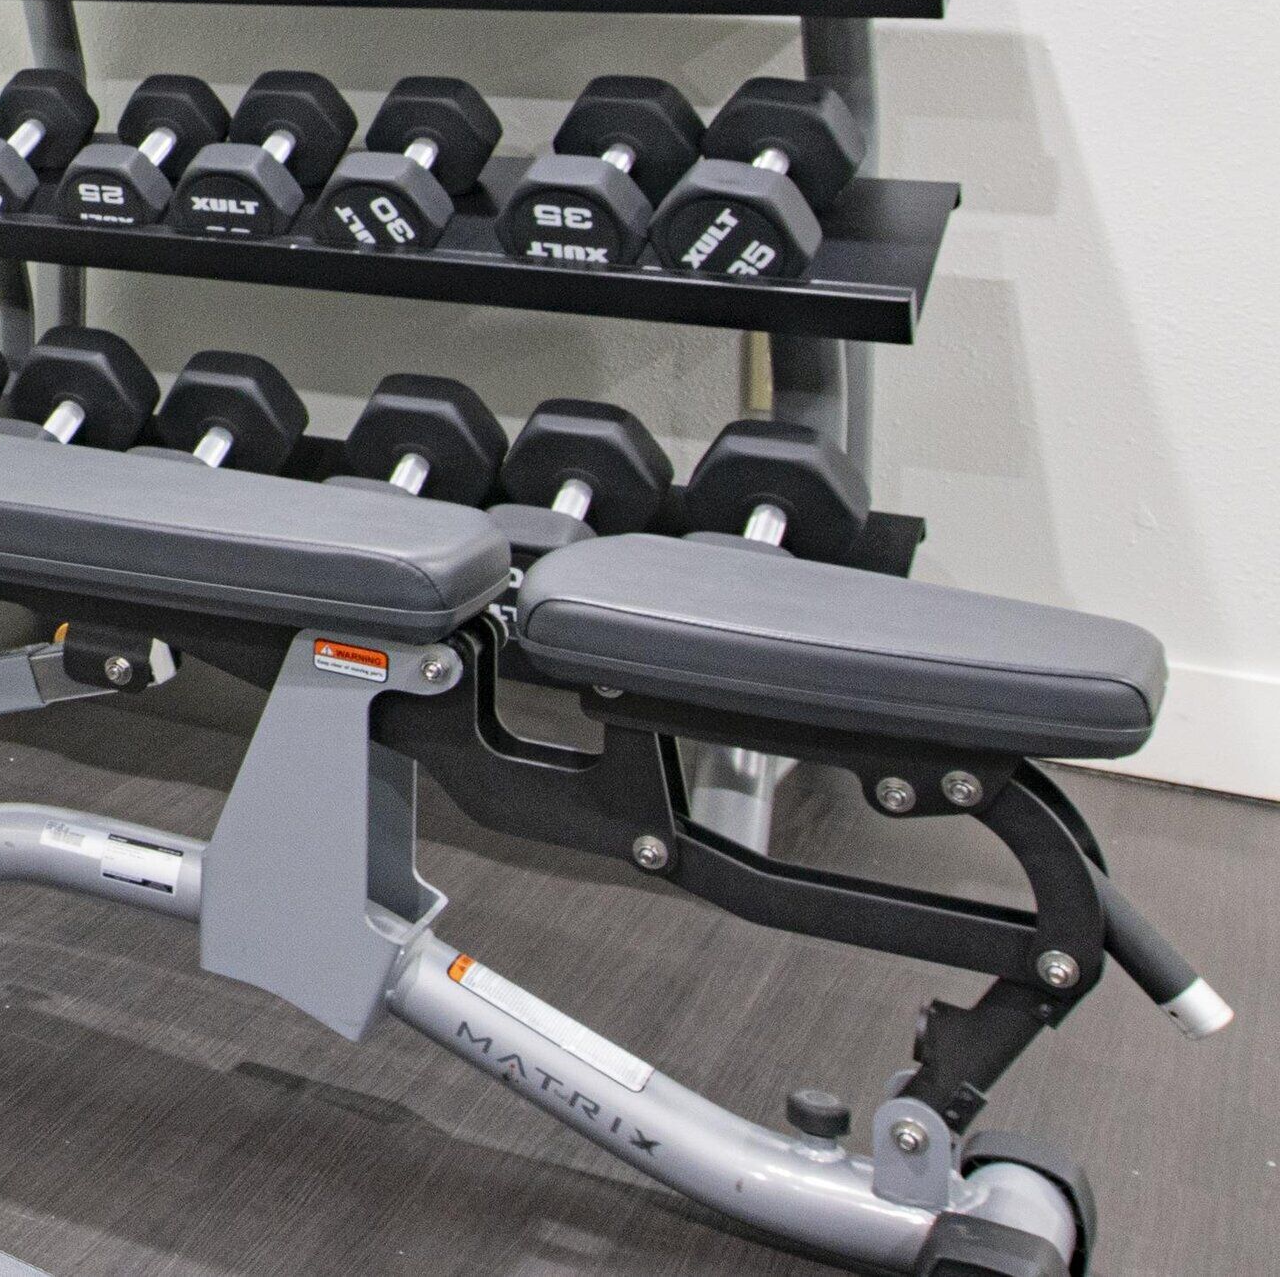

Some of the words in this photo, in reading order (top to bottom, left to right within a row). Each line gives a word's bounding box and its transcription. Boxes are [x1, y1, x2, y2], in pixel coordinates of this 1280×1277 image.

[78, 183, 125, 205] 25
[191, 186, 260, 215] XULT
[369, 196, 416, 244] 30
[533, 204, 593, 230] 35
[681, 207, 739, 270] XULT
[526, 241, 610, 264] XULT
[335, 649, 384, 666] WARNING
[456, 1021, 662, 1156] MATRIX
